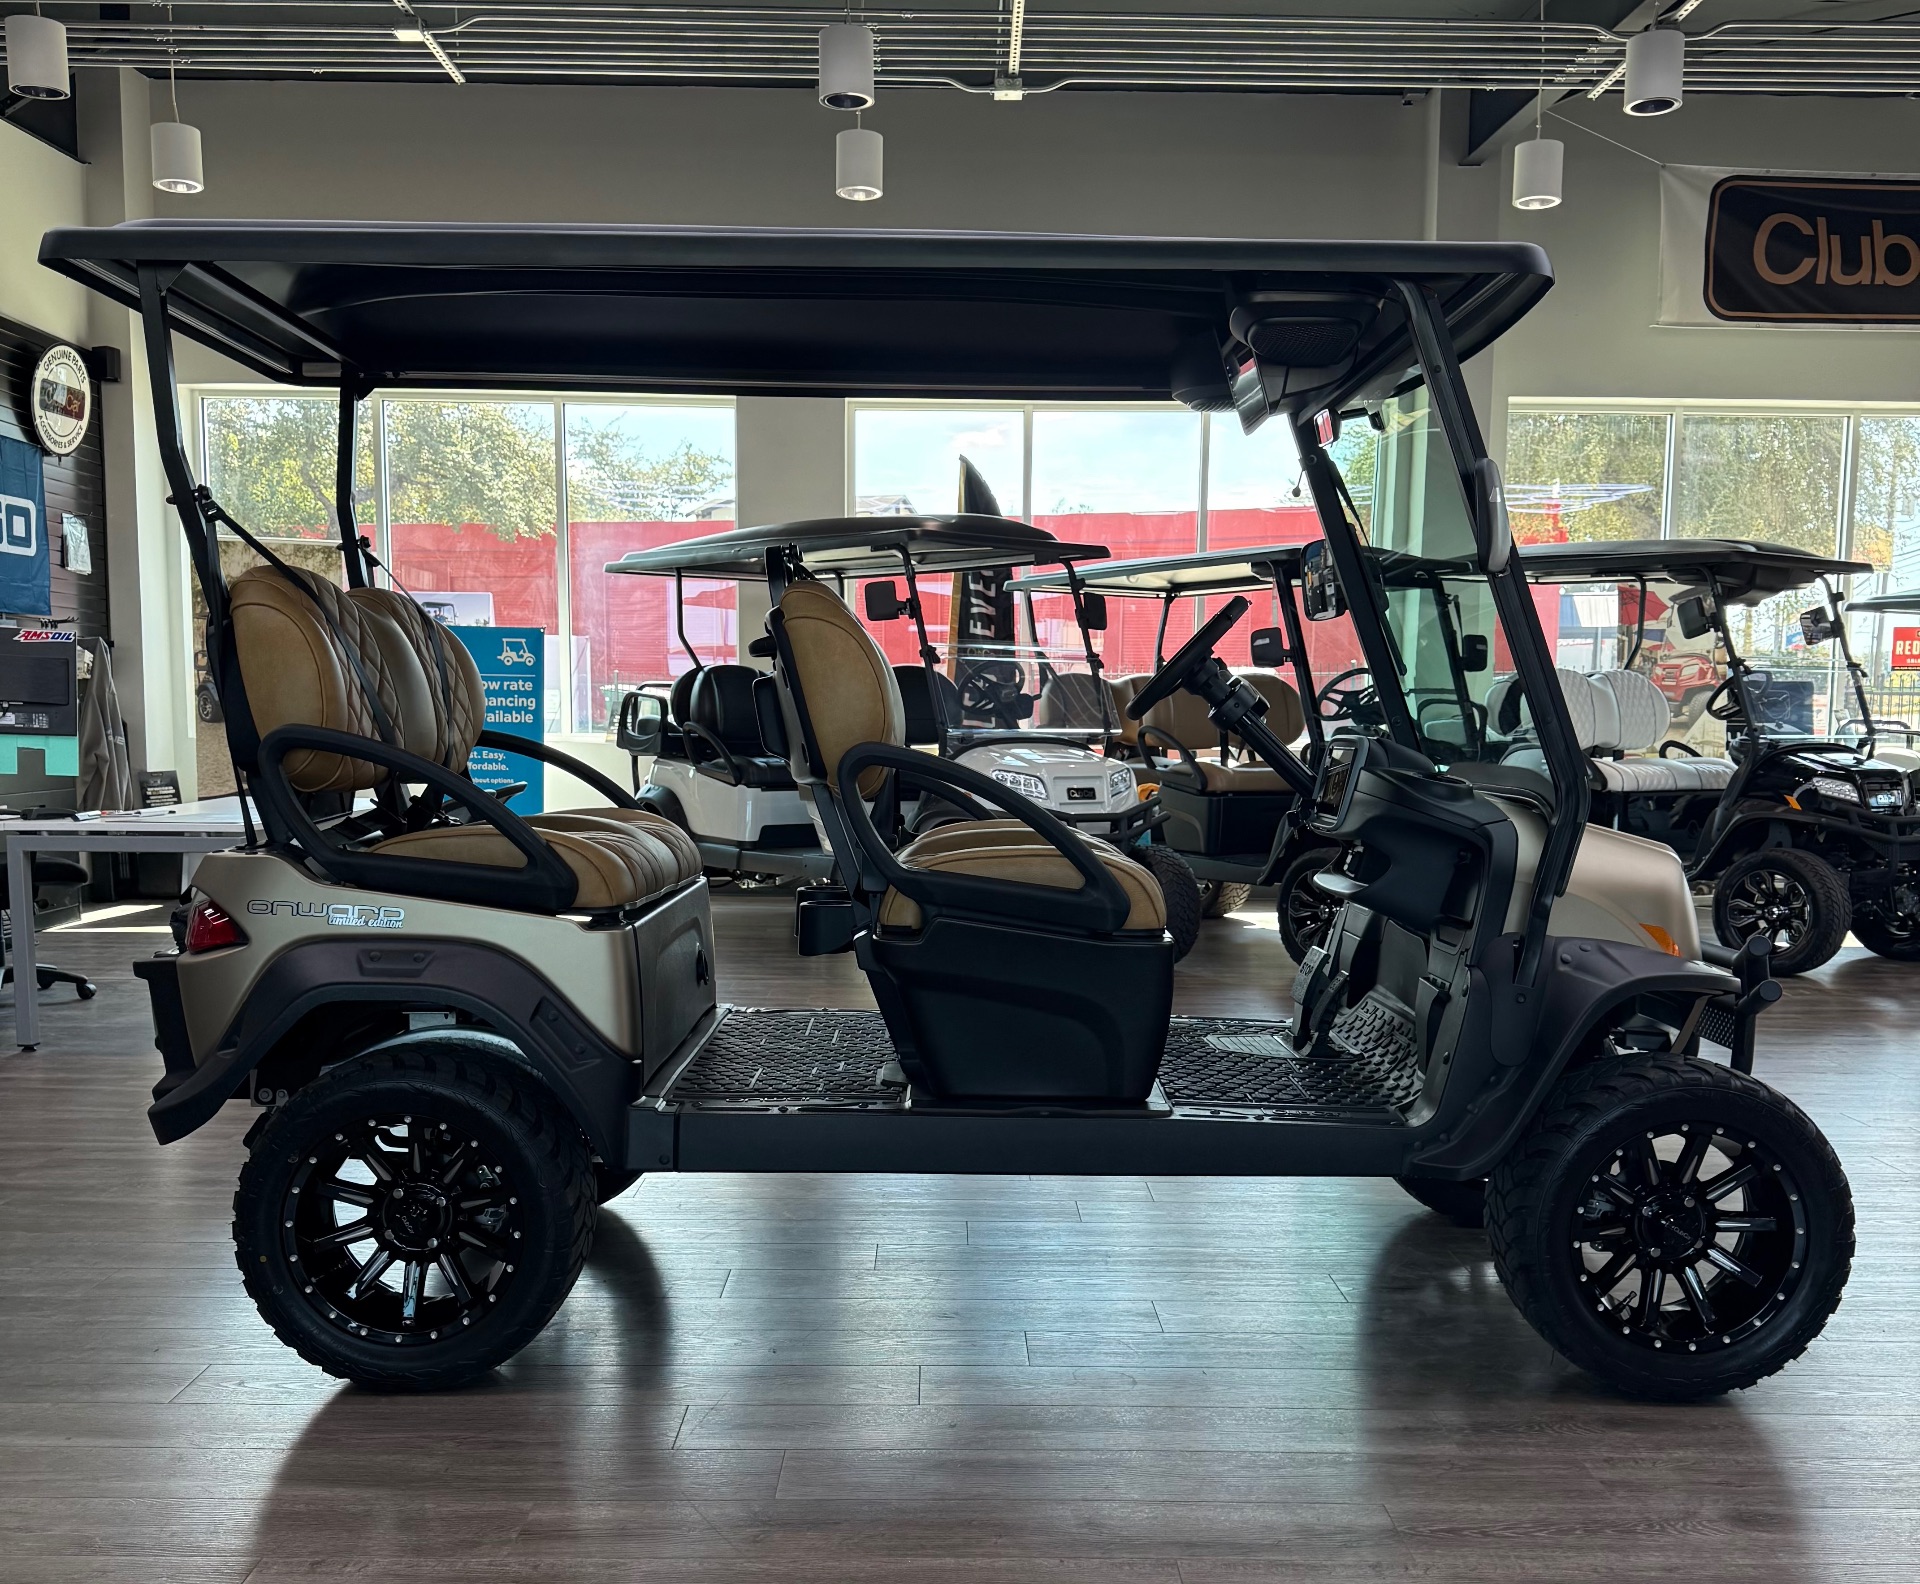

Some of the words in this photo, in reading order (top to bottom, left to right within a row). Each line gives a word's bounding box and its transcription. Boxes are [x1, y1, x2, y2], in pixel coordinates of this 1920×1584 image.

[1753, 212, 1920, 287] Club
[43, 349, 73, 371] GENUINE
[71, 355, 87, 384] PARTS
[38, 415, 64, 449] ACCESSORIES
[66, 425, 84, 447] SERVICE
[17, 629, 75, 642] AMSOIL
[503, 679, 533, 691] rate
[485, 710, 534, 723] ailable
[482, 750, 506, 761] Easy.
[490, 777, 515, 785] options
[327, 914, 366, 928] limited
[368, 916, 404, 929] edition
